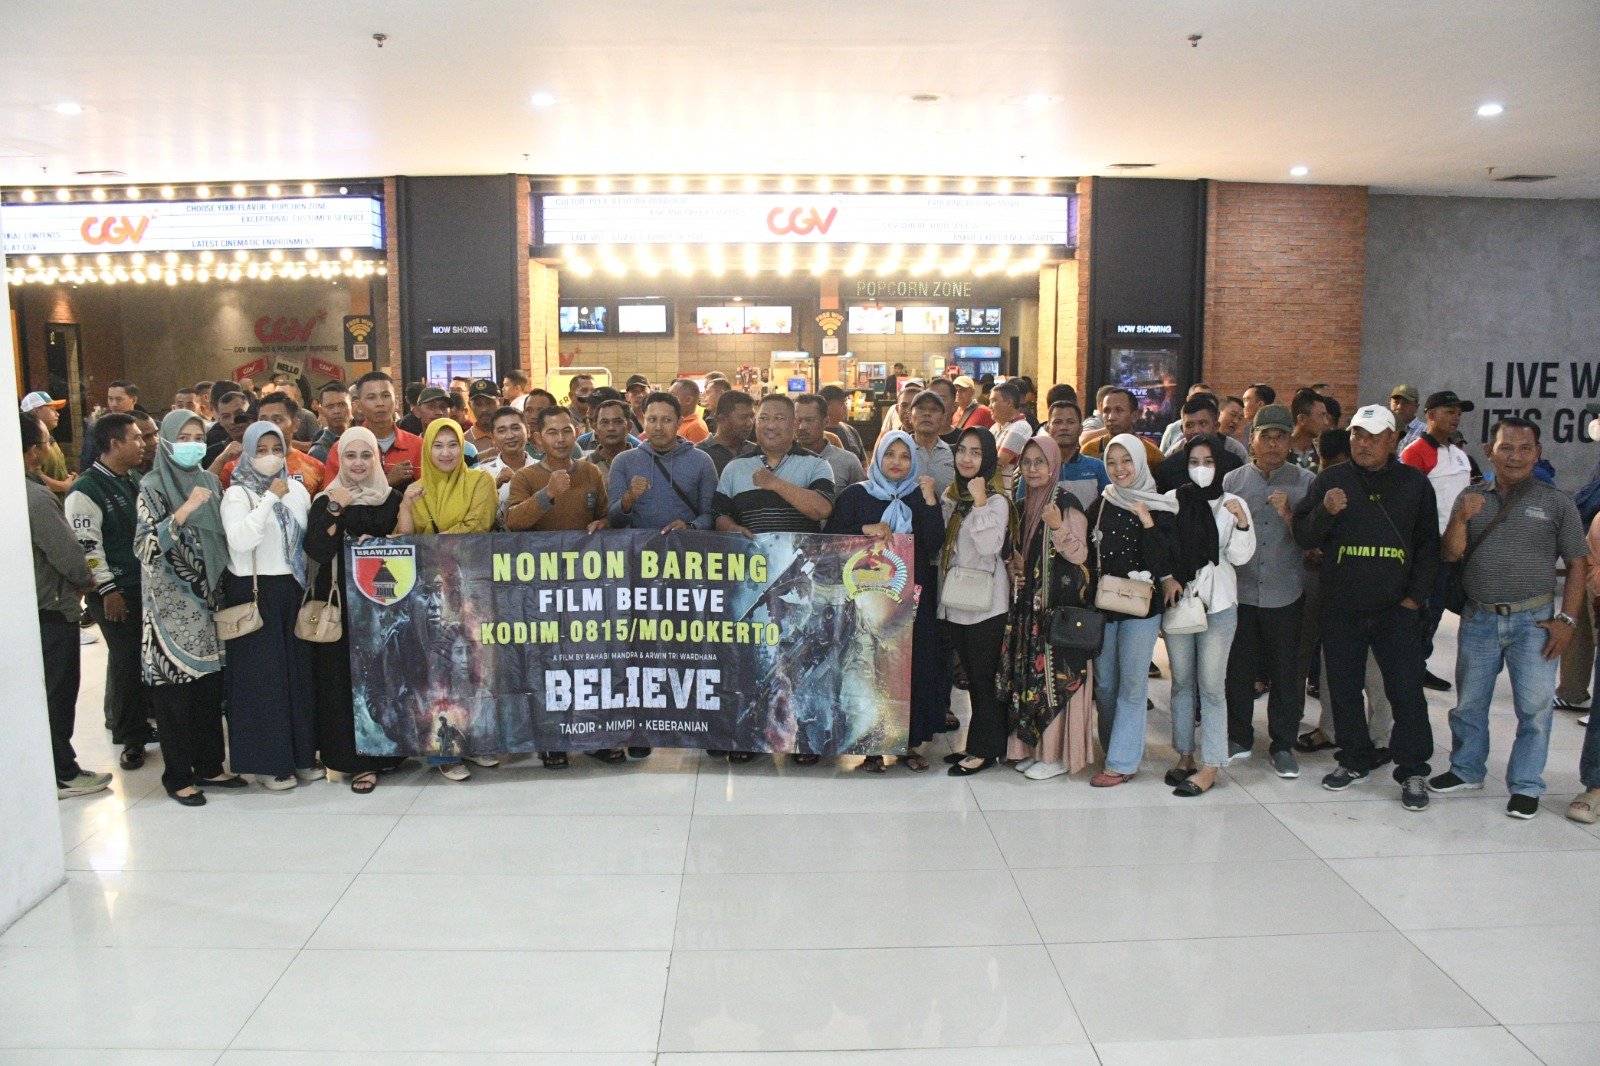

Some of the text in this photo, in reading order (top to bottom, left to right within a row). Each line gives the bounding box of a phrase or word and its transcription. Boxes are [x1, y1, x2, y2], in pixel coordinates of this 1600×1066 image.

[238, 203, 266, 211] FLAVOR
[767, 207, 838, 235] CGV
[80, 215, 149, 245] CGV
[220, 239, 260, 247] CINEMATIC
[856, 281, 972, 297] POPCORN ZONE
[254, 315, 317, 343] CGV
[432, 325, 488, 334] NOW SHOWING
[1117, 325, 1172, 334] NOW SHOWING
[276, 362, 299, 375] HELLO
[1485, 361, 1600, 398] LIVE W
[73, 518, 91, 529] GO
[356, 548, 410, 556] BRAWIJAYA
[492, 550, 768, 584] NONTON BARENG
[539, 587, 724, 613] FILM BELIEVE
[481, 618, 780, 647] KODIM 0815/MOJOKERTO
[575, 653, 584, 661] BY
[585, 652, 610, 660] RAHABI
[611, 651, 639, 659] MANDRA
[645, 651, 667, 659] ARWIN
[679, 652, 718, 661] WARDHANA
[545, 666, 721, 712] BELIEVE
[559, 719, 708, 735] TAKDIR MIMPI KEBERANIAN
